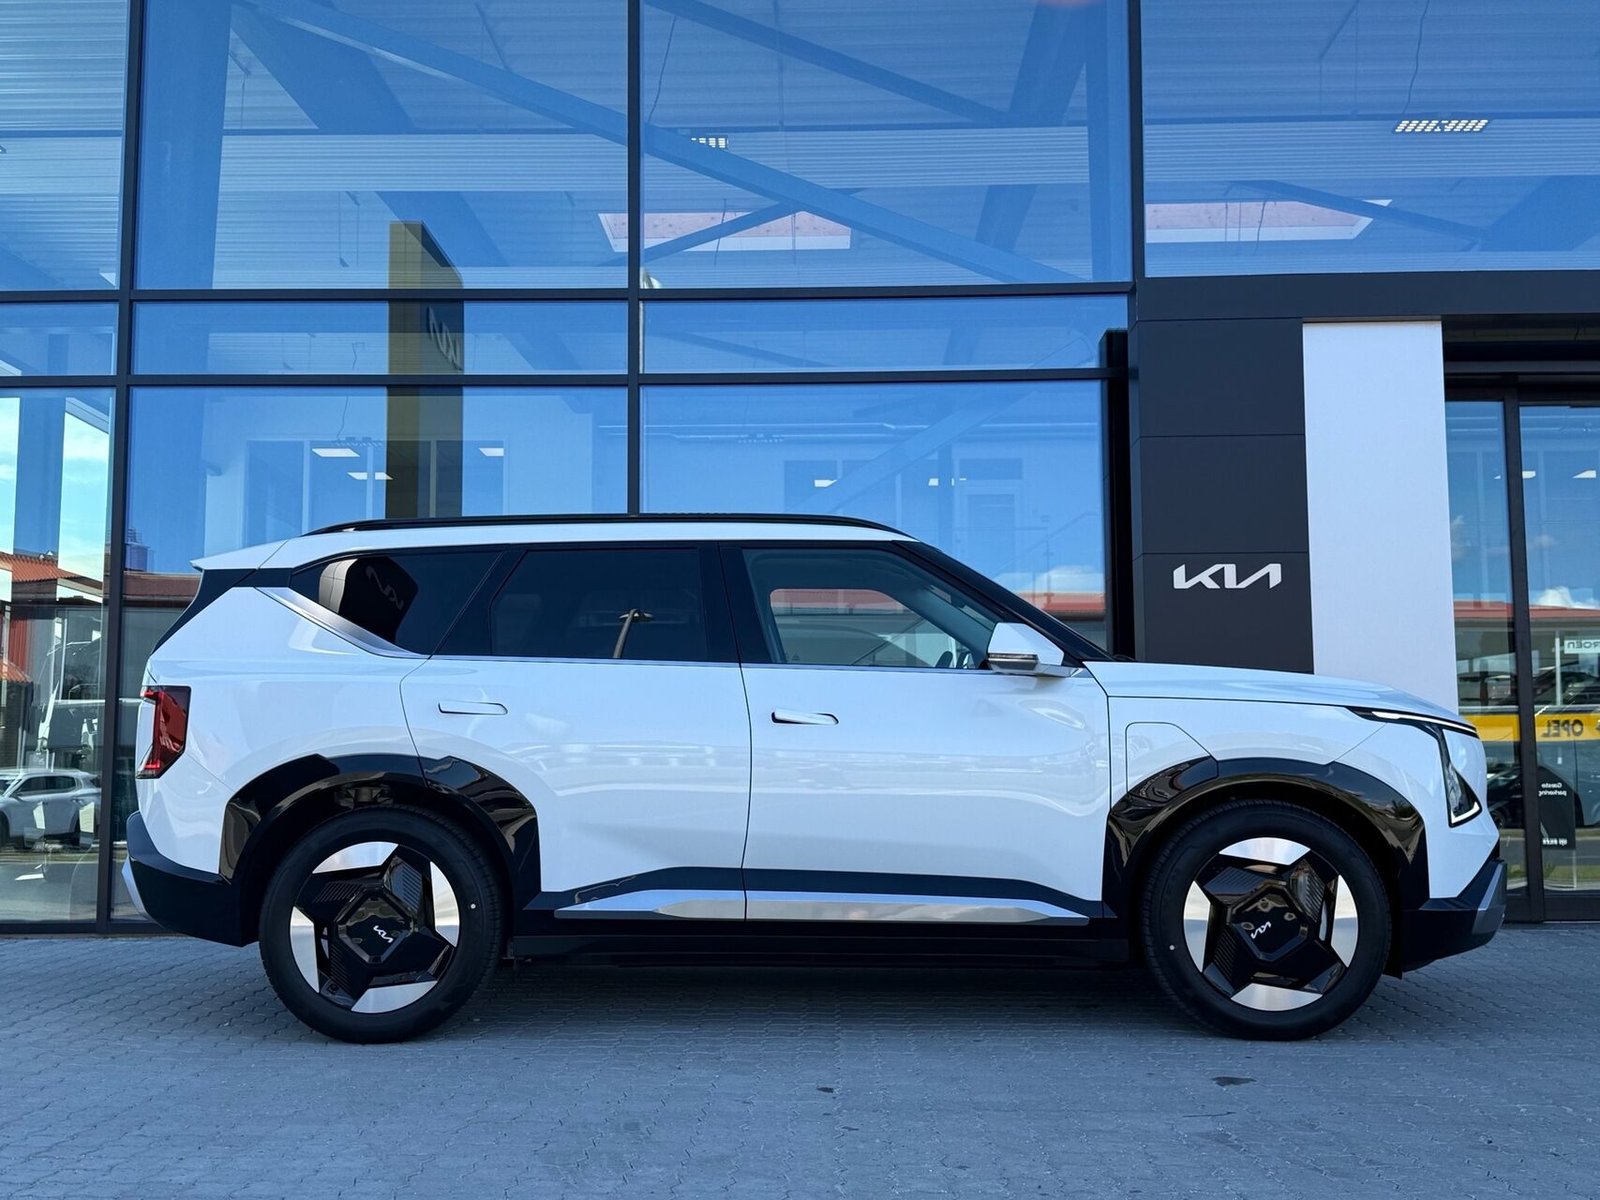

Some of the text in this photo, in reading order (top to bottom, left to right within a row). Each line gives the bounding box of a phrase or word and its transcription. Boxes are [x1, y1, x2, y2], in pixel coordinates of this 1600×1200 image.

[1173, 563, 1282, 589] KIA
[373, 925, 394, 943] KIA
[1250, 921, 1272, 939] KIA
